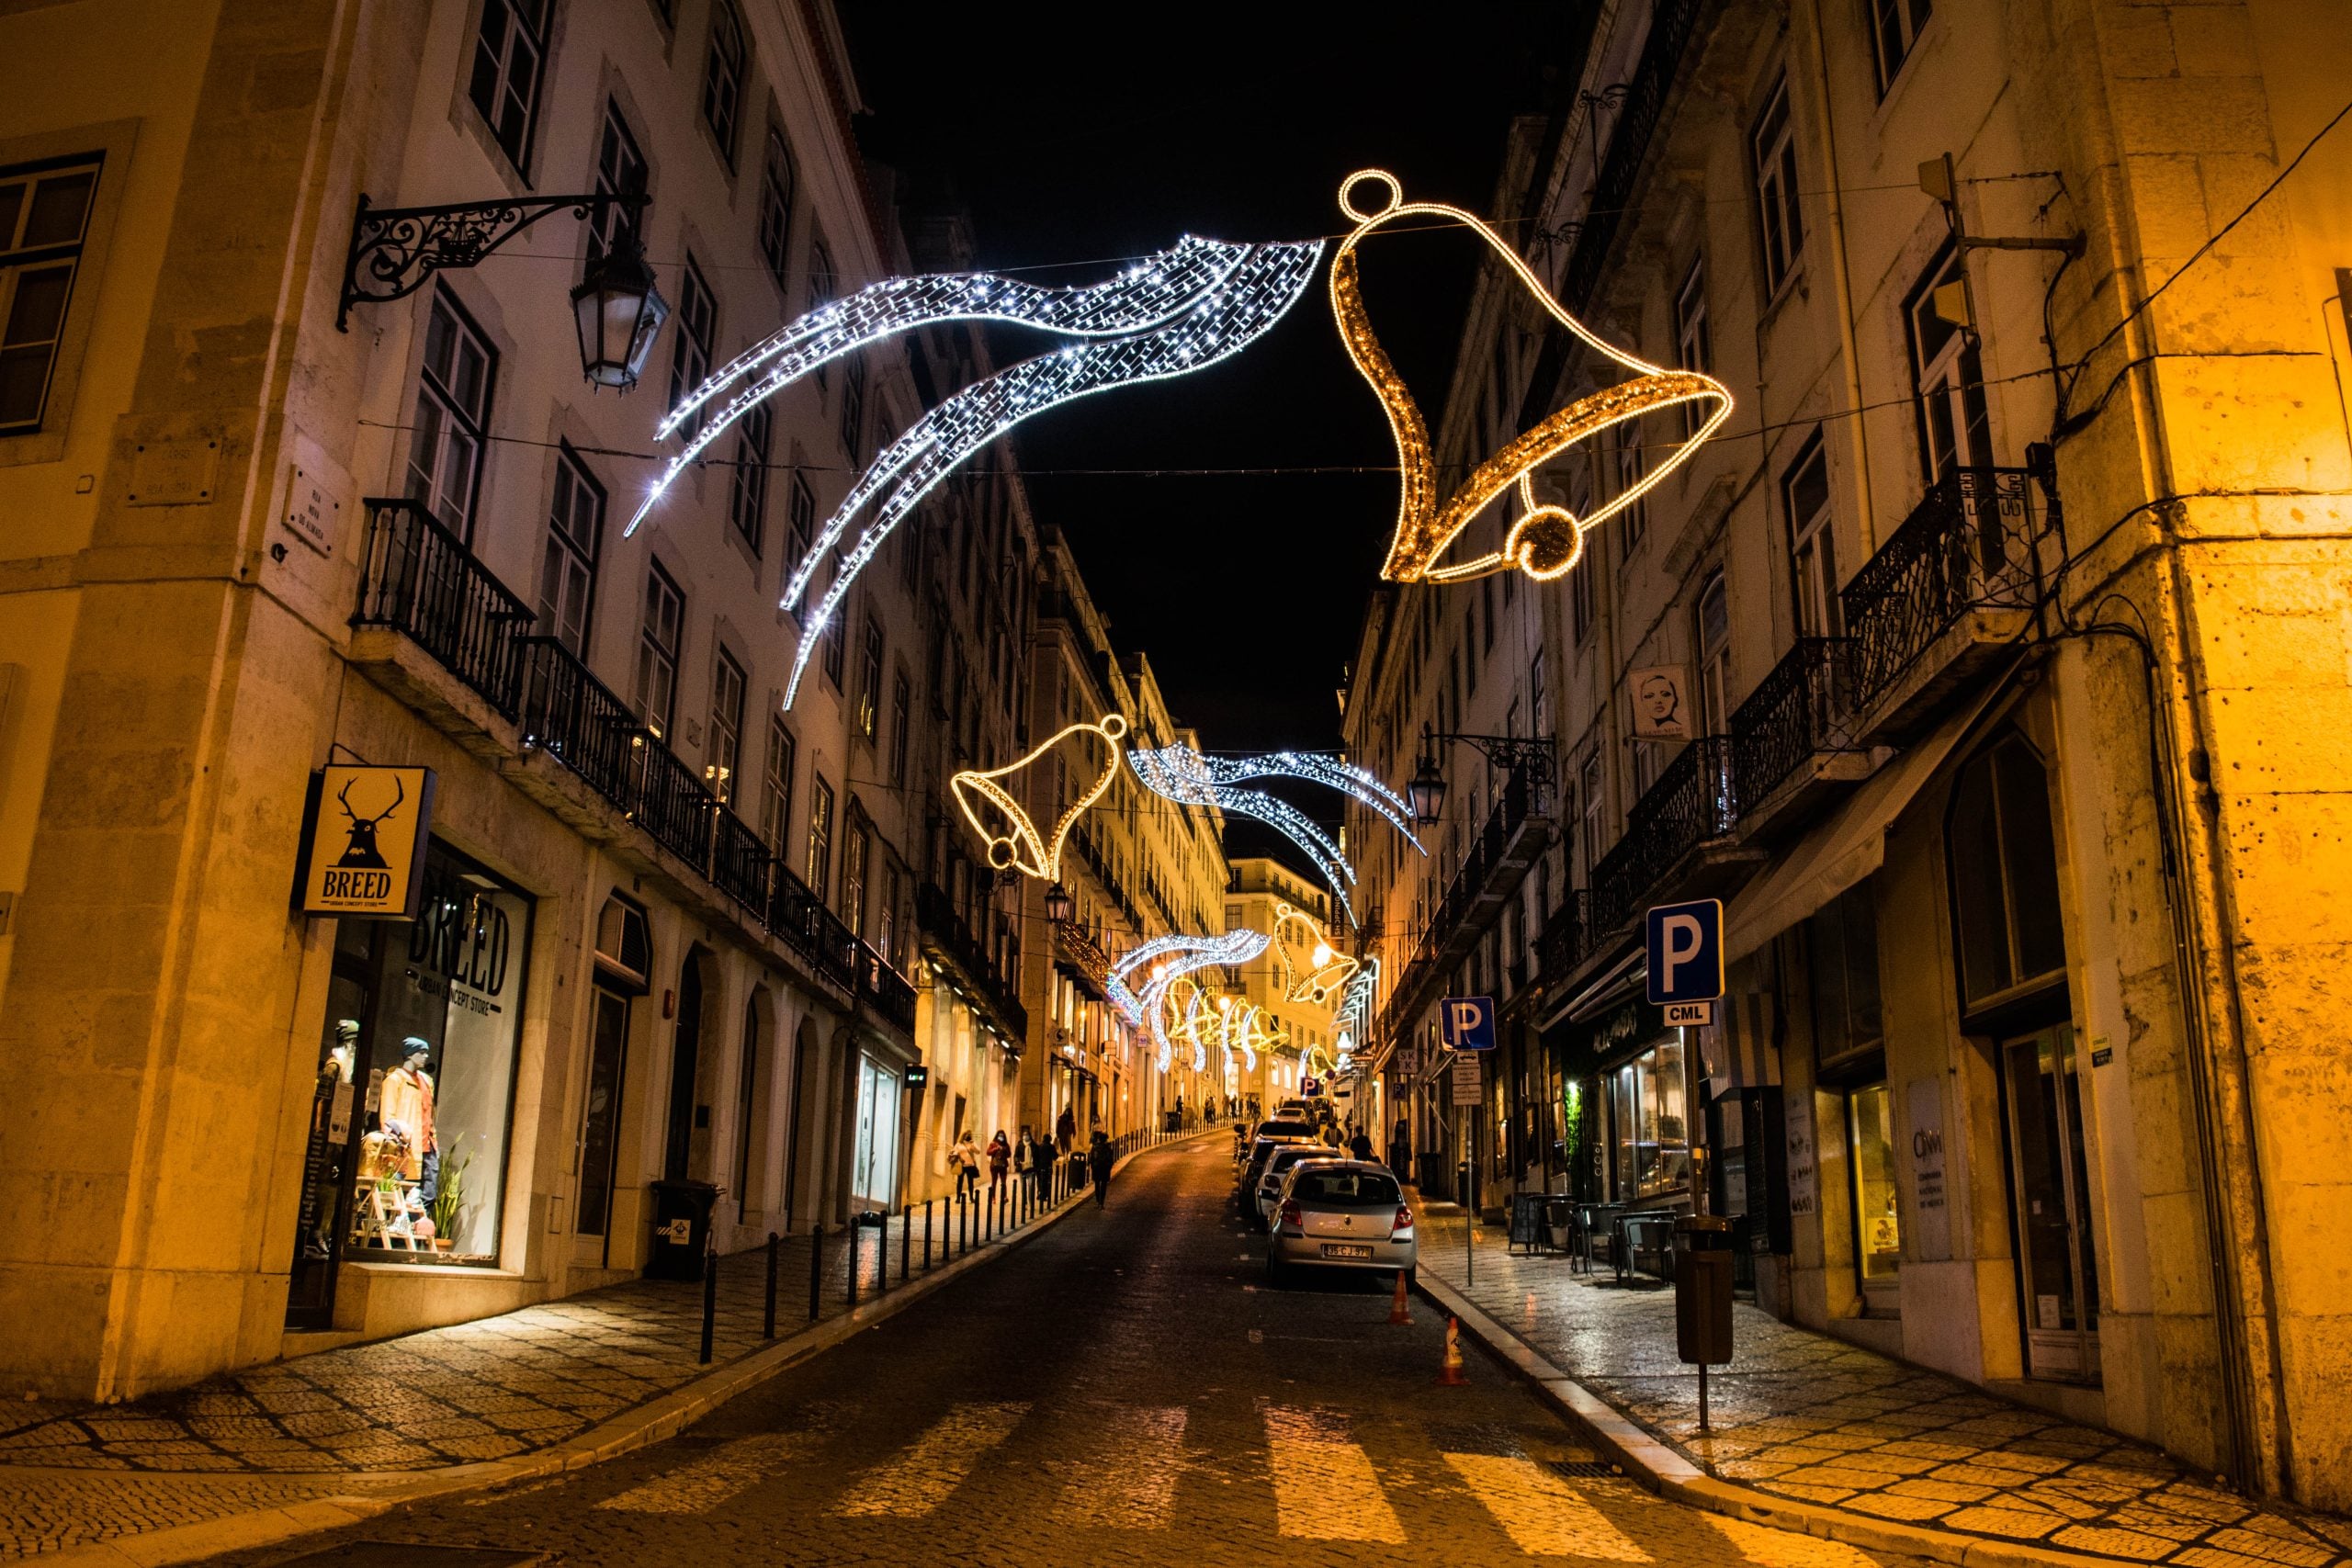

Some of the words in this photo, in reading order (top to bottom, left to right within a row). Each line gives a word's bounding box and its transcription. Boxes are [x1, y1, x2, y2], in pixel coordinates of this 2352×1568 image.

[312, 489, 321, 503] RUA
[309, 504, 320, 520] NOVA
[322, 871, 391, 898] BREED
[408, 863, 509, 997] BREED
[1662, 913, 1703, 993] P
[419, 975, 441, 996] URBAN
[470, 996, 490, 1017] STORE
[1452, 1002, 1482, 1045] P
[1669, 1006, 1702, 1021] CML
[1305, 1078, 1316, 1096] P
